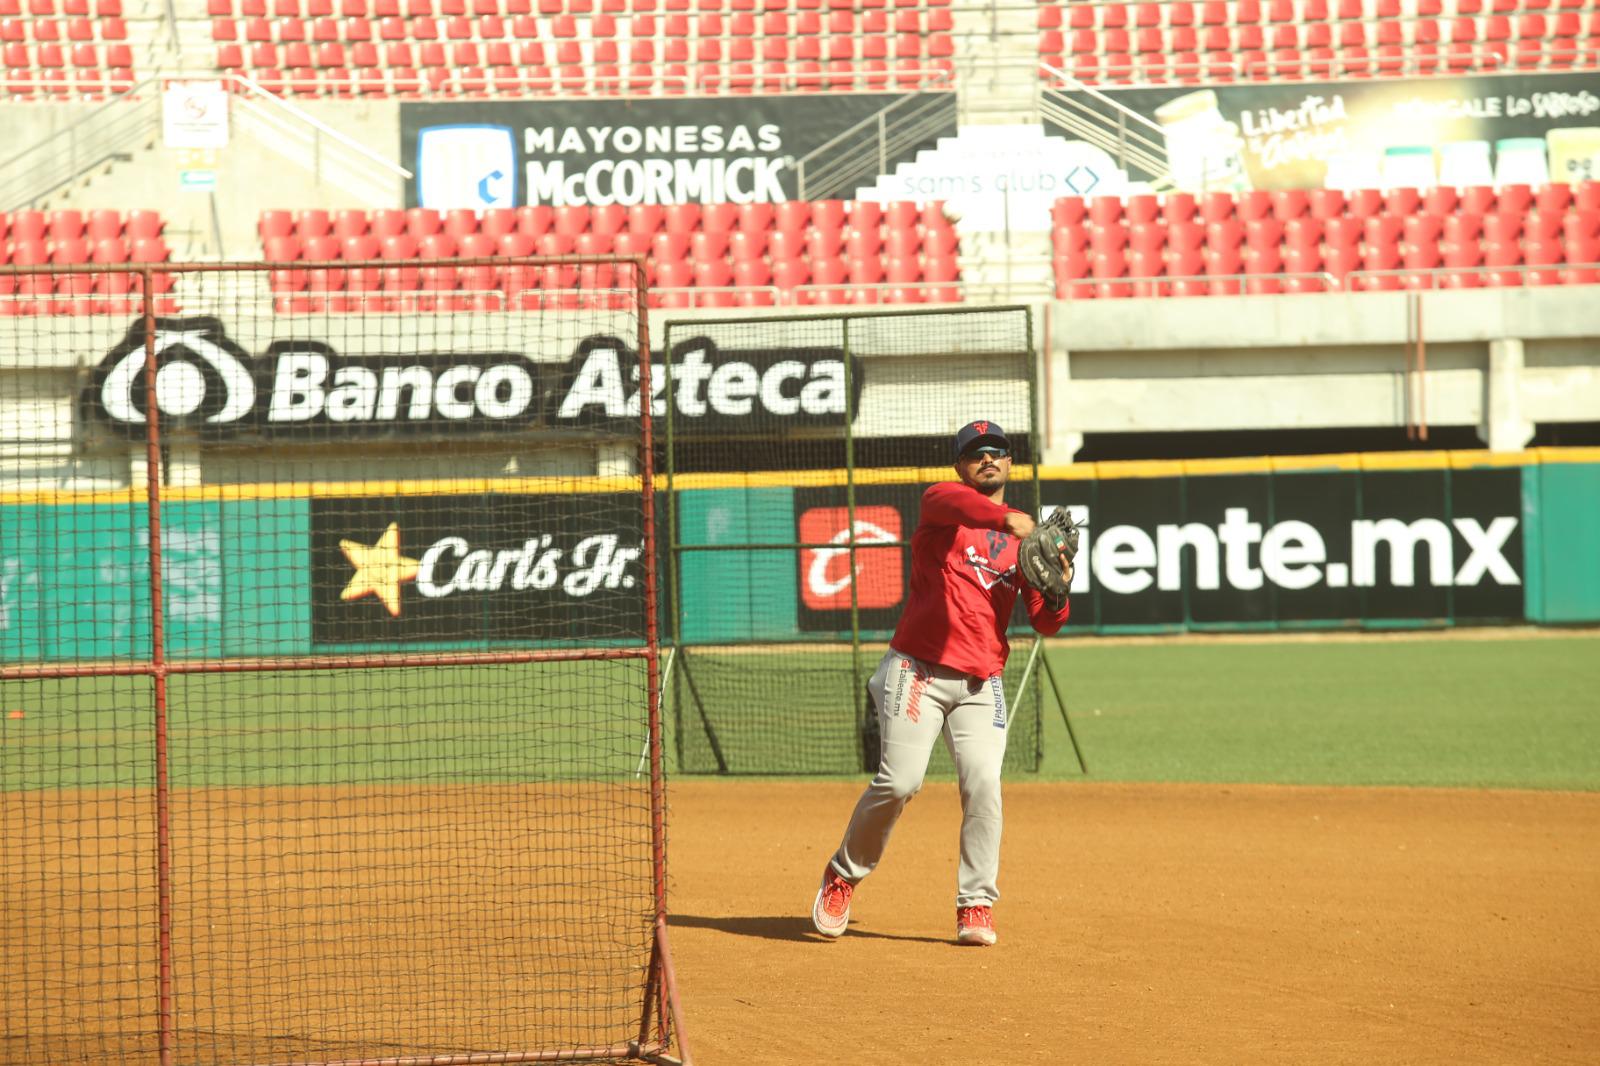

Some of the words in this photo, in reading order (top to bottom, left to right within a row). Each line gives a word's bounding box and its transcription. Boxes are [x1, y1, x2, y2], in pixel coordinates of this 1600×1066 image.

[524, 124, 782, 154] MAYONESAS
[525, 157, 787, 206] McCORMICK
[994, 169, 1057, 193] club
[268, 350, 533, 423] Banco
[558, 345, 849, 421] Azteca
[416, 534, 563, 598] Carl's
[563, 534, 641, 598] Jr.
